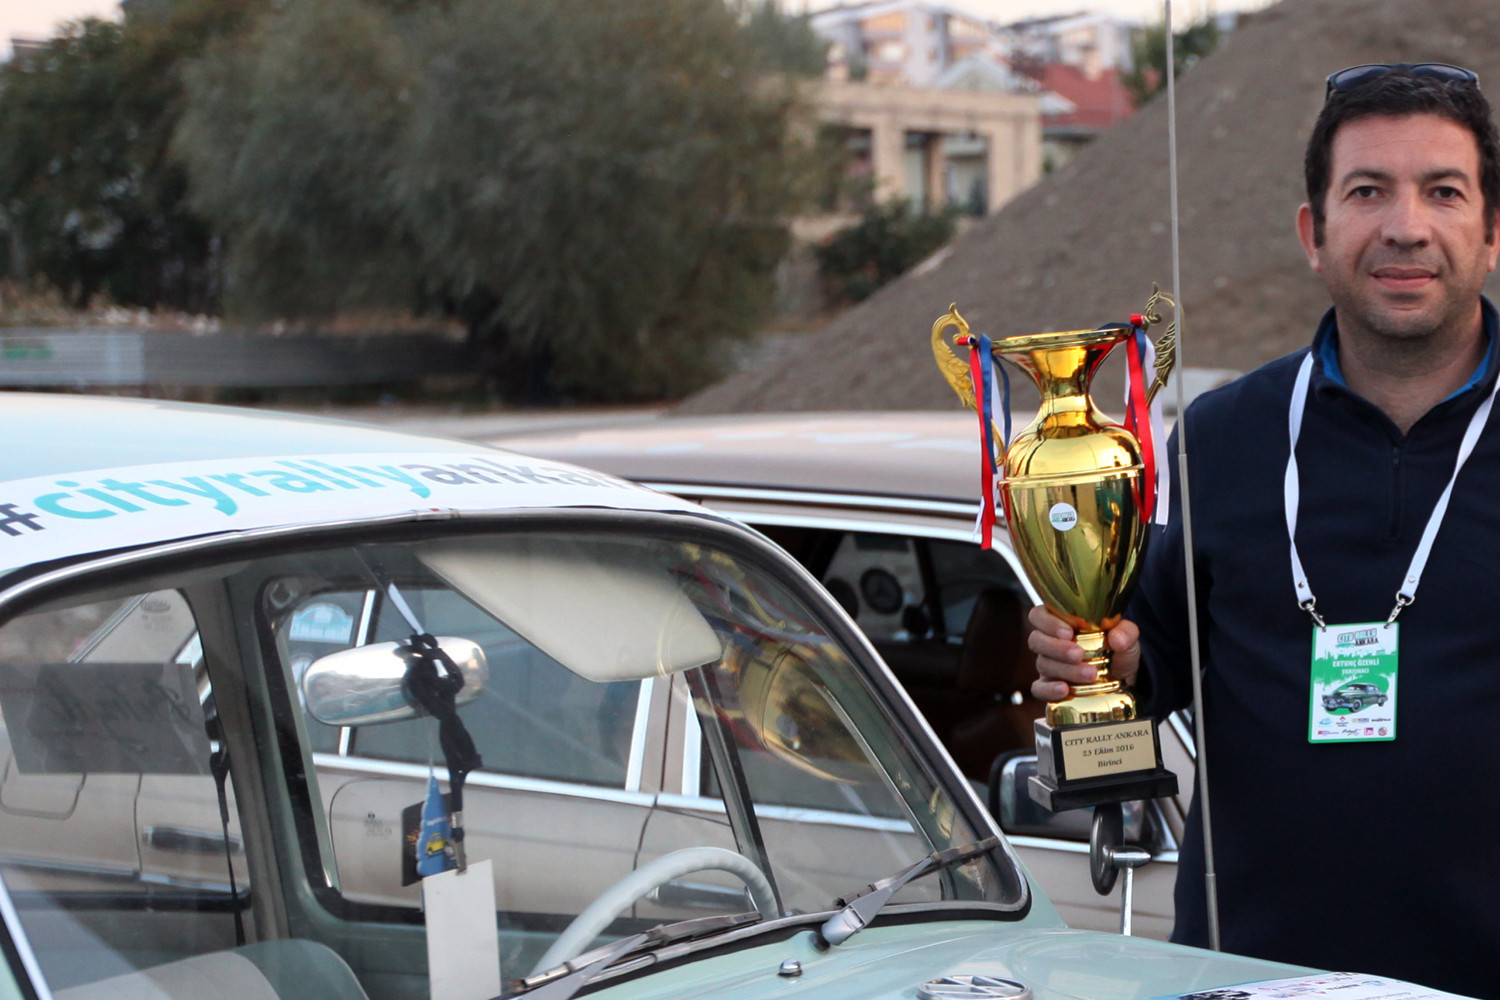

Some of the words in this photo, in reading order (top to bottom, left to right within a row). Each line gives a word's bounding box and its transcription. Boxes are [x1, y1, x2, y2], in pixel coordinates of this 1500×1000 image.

[1064, 738, 1084, 747] CITY
[1086, 734, 1113, 744] RALLY
[1114, 729, 1149, 740] ANKARA
[1094, 748, 1114, 756] Ekim
[1116, 744, 1135, 752] 2016
[1097, 758, 1122, 768] Birinci
